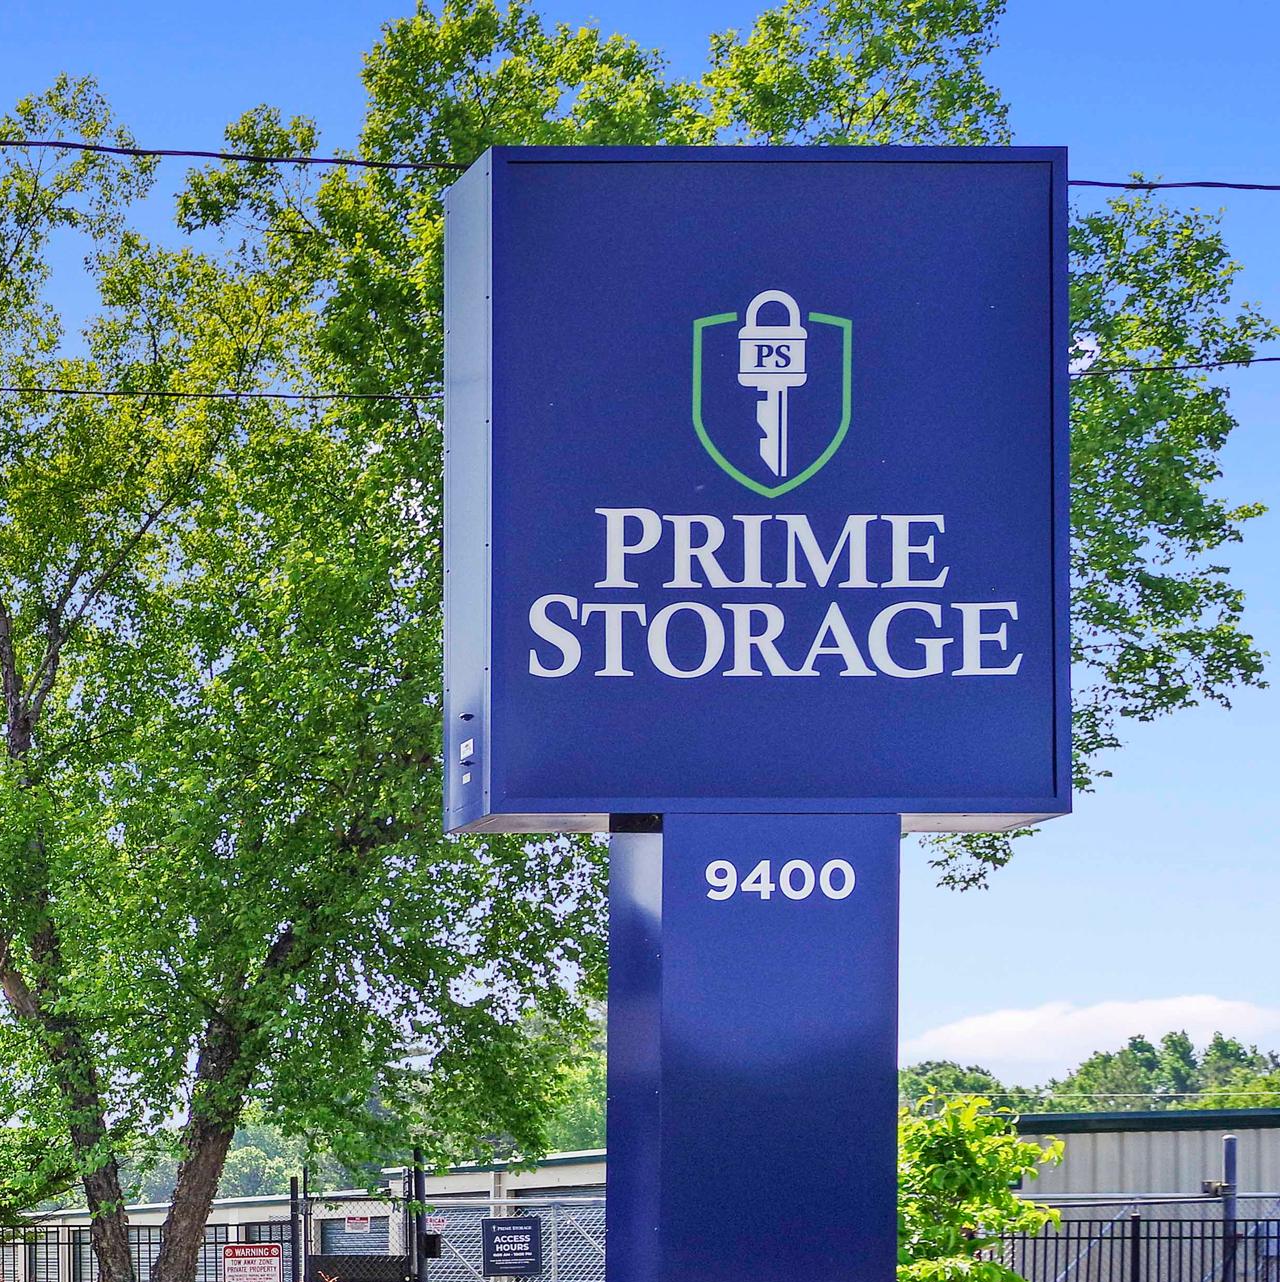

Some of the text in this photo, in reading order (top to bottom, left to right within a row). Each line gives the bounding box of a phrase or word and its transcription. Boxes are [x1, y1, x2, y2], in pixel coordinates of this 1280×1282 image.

[754, 343, 792, 369] PS
[593, 507, 951, 589] PRIME
[527, 593, 1024, 679] STORAGE
[704, 858, 857, 901] 9400
[234, 1248, 269, 1256] WARNING
[494, 1235, 531, 1243] ACCESS
[496, 1243, 530, 1251] HOURS
